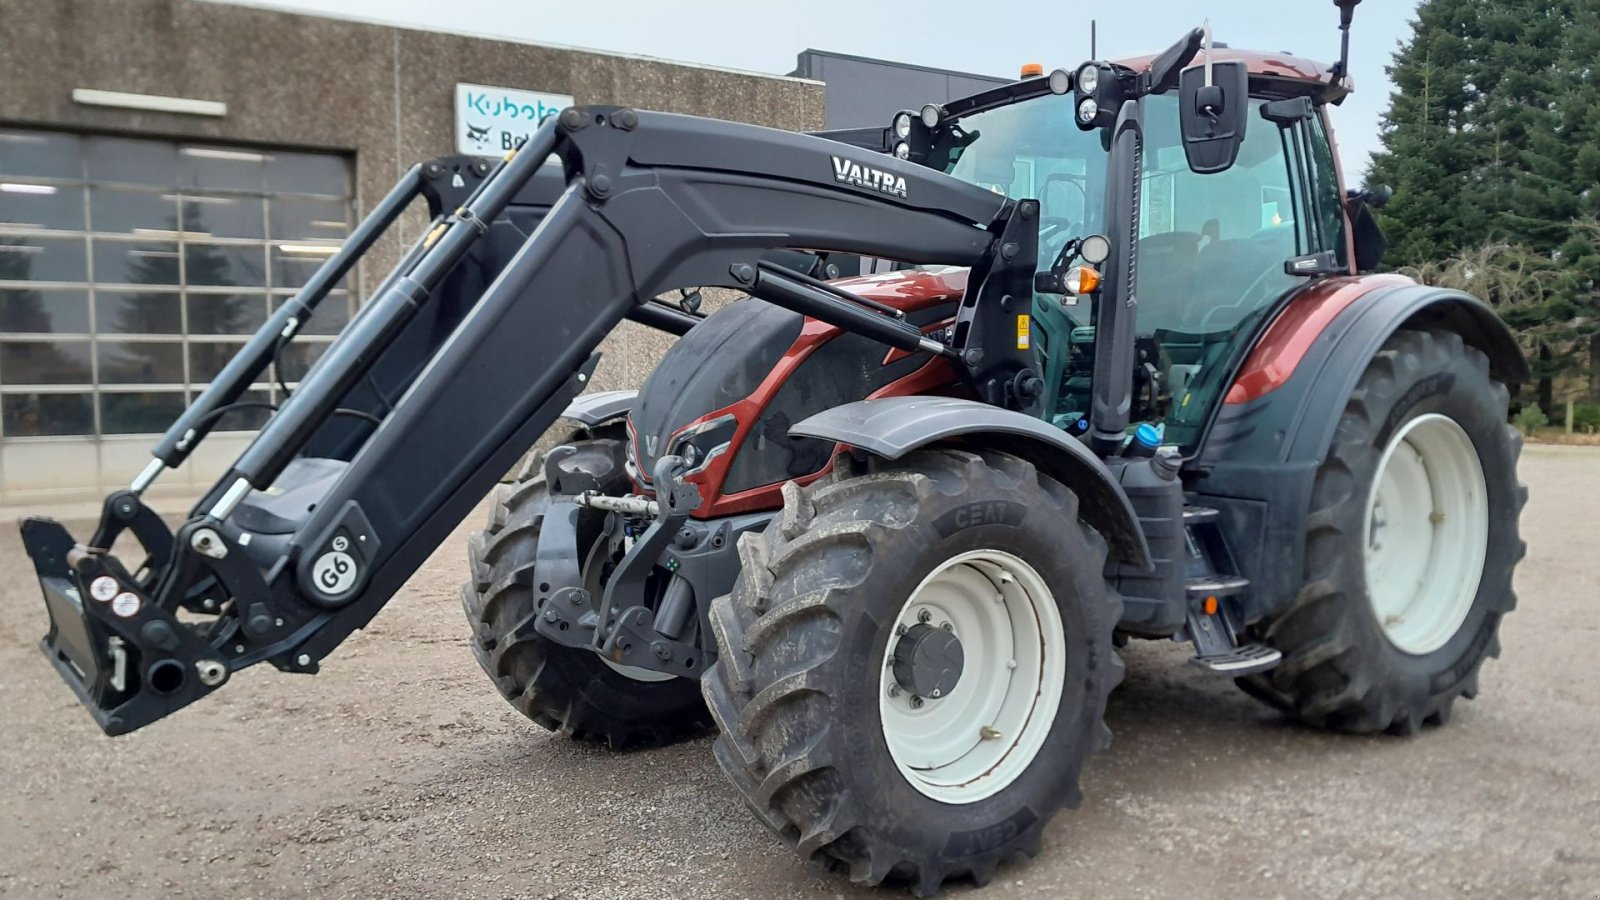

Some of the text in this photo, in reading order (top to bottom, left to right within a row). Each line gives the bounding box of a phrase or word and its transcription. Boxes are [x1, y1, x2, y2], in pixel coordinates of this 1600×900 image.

[831, 155, 907, 198] VALTRA
[956, 503, 1006, 528] CEAT
[321, 555, 349, 588] G6
